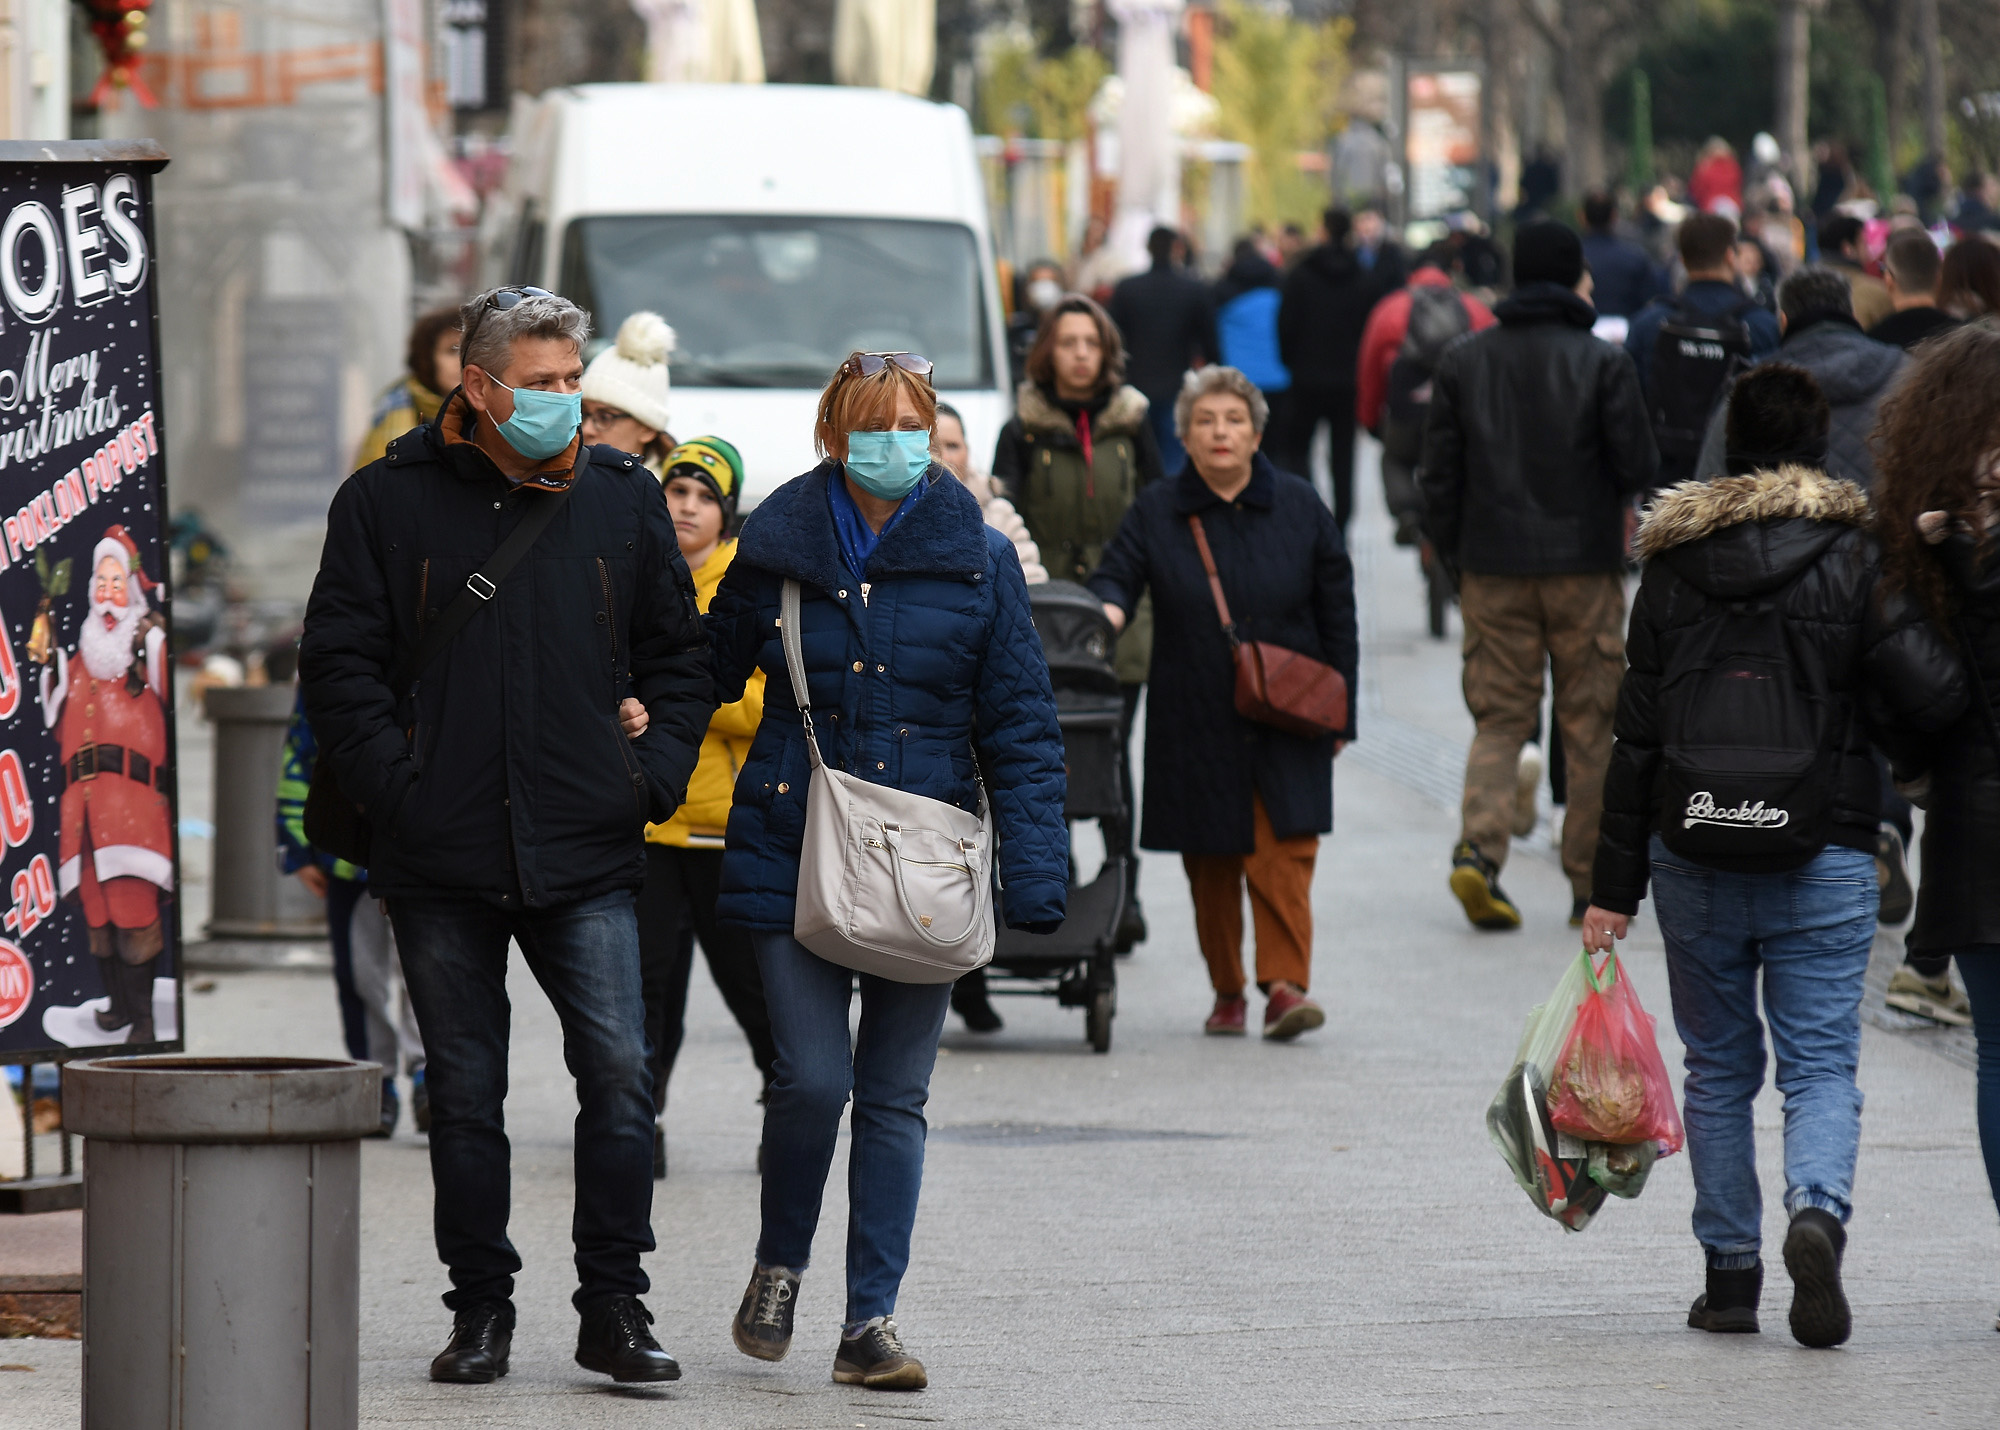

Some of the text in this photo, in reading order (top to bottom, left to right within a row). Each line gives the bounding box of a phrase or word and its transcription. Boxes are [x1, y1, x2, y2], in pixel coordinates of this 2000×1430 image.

[0, 173, 148, 335] OES
[3, 467, 89, 563] POKLON
[81, 410, 158, 504] POPUST
[1684, 791, 1789, 829] Brooklyn
[3, 853, 57, 939] -20
